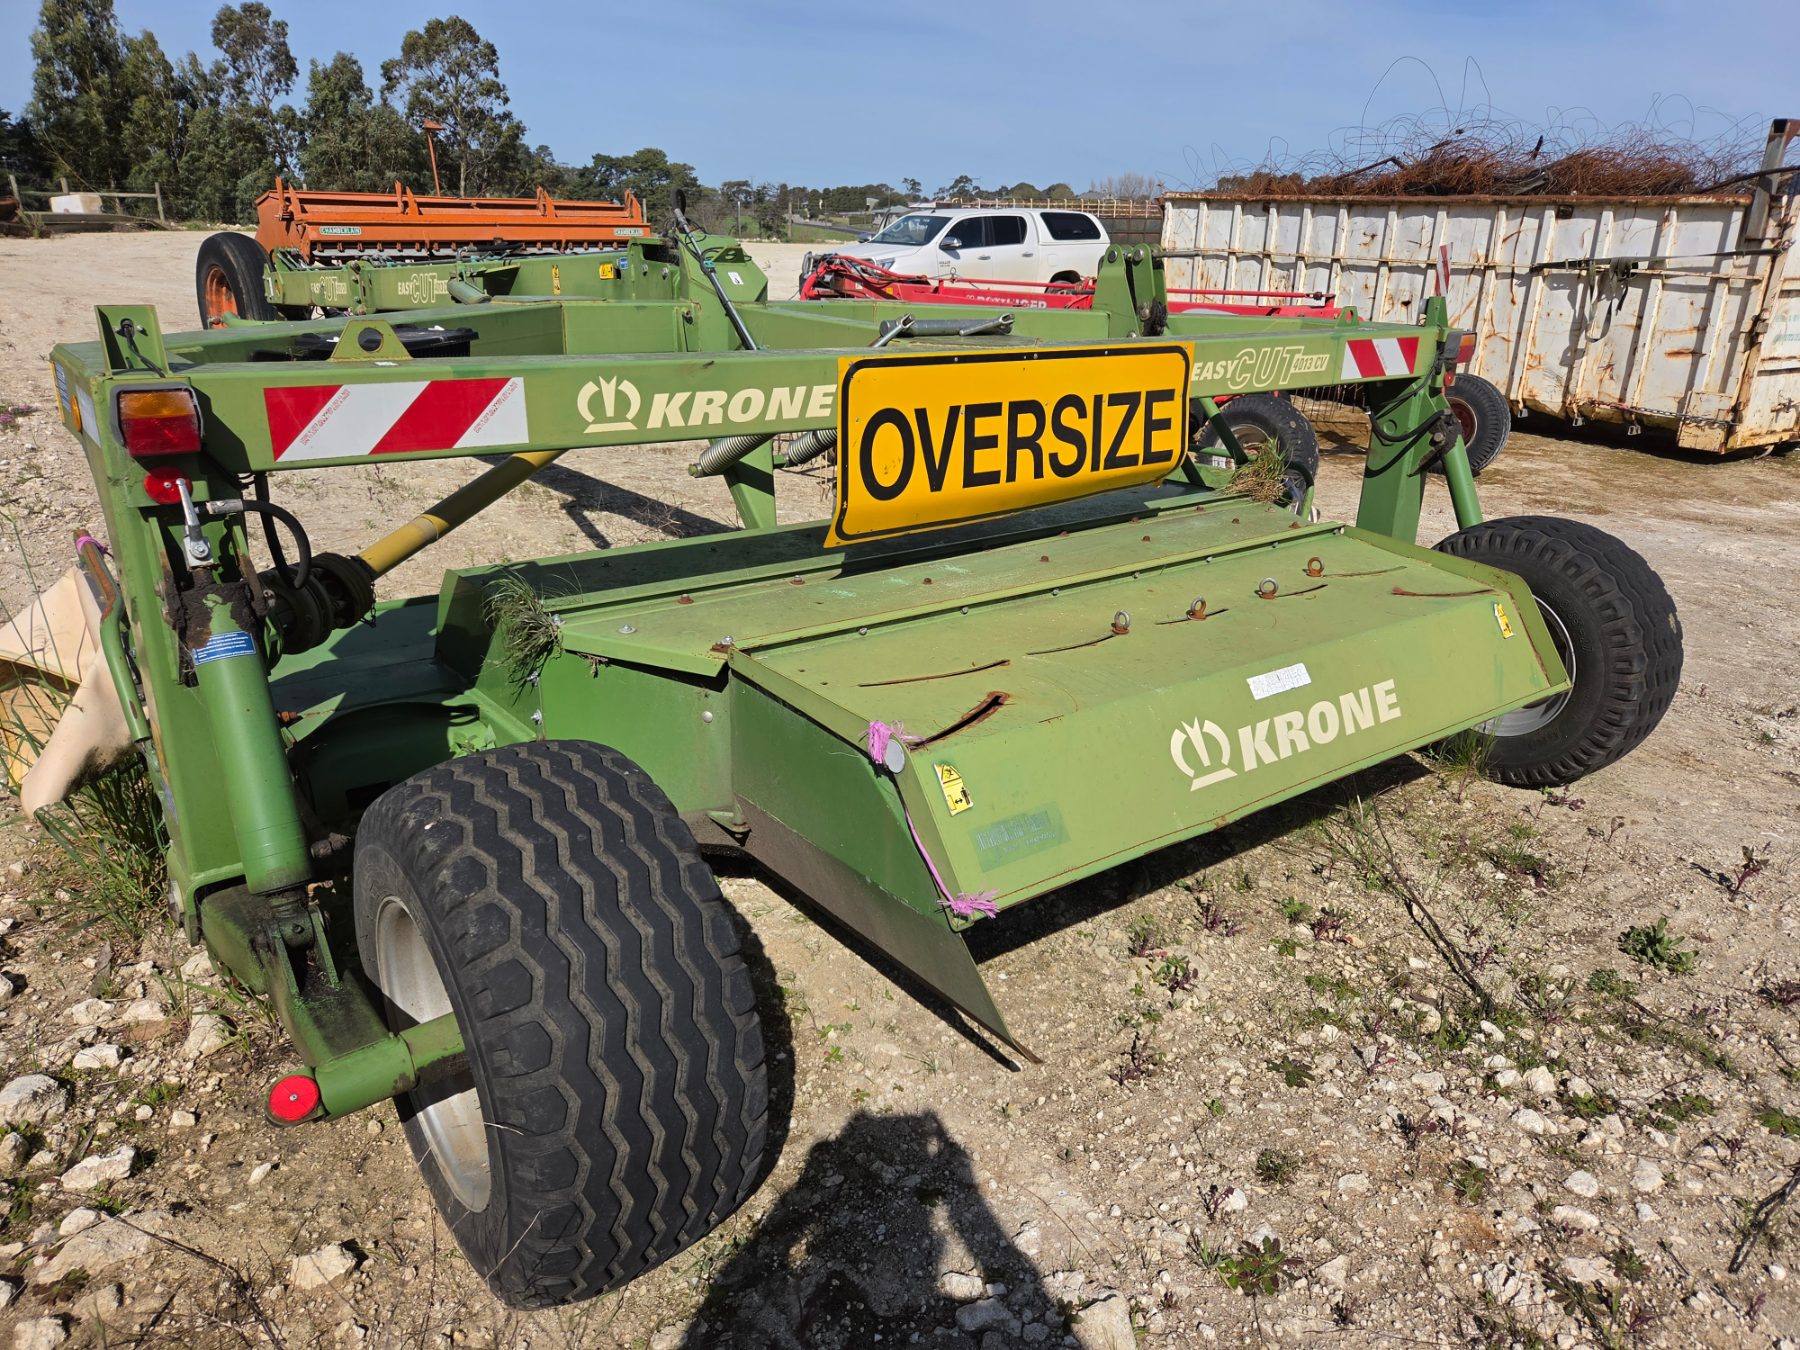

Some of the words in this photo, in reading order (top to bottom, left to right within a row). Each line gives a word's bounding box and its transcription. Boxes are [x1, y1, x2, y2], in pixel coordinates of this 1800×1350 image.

[1293, 357, 1313, 370] 4013
[1313, 356, 1328, 369] CV
[646, 384, 838, 429] KRONE
[859, 388, 1176, 501] OVERSIZE
[1238, 679, 1401, 772] KRONE
